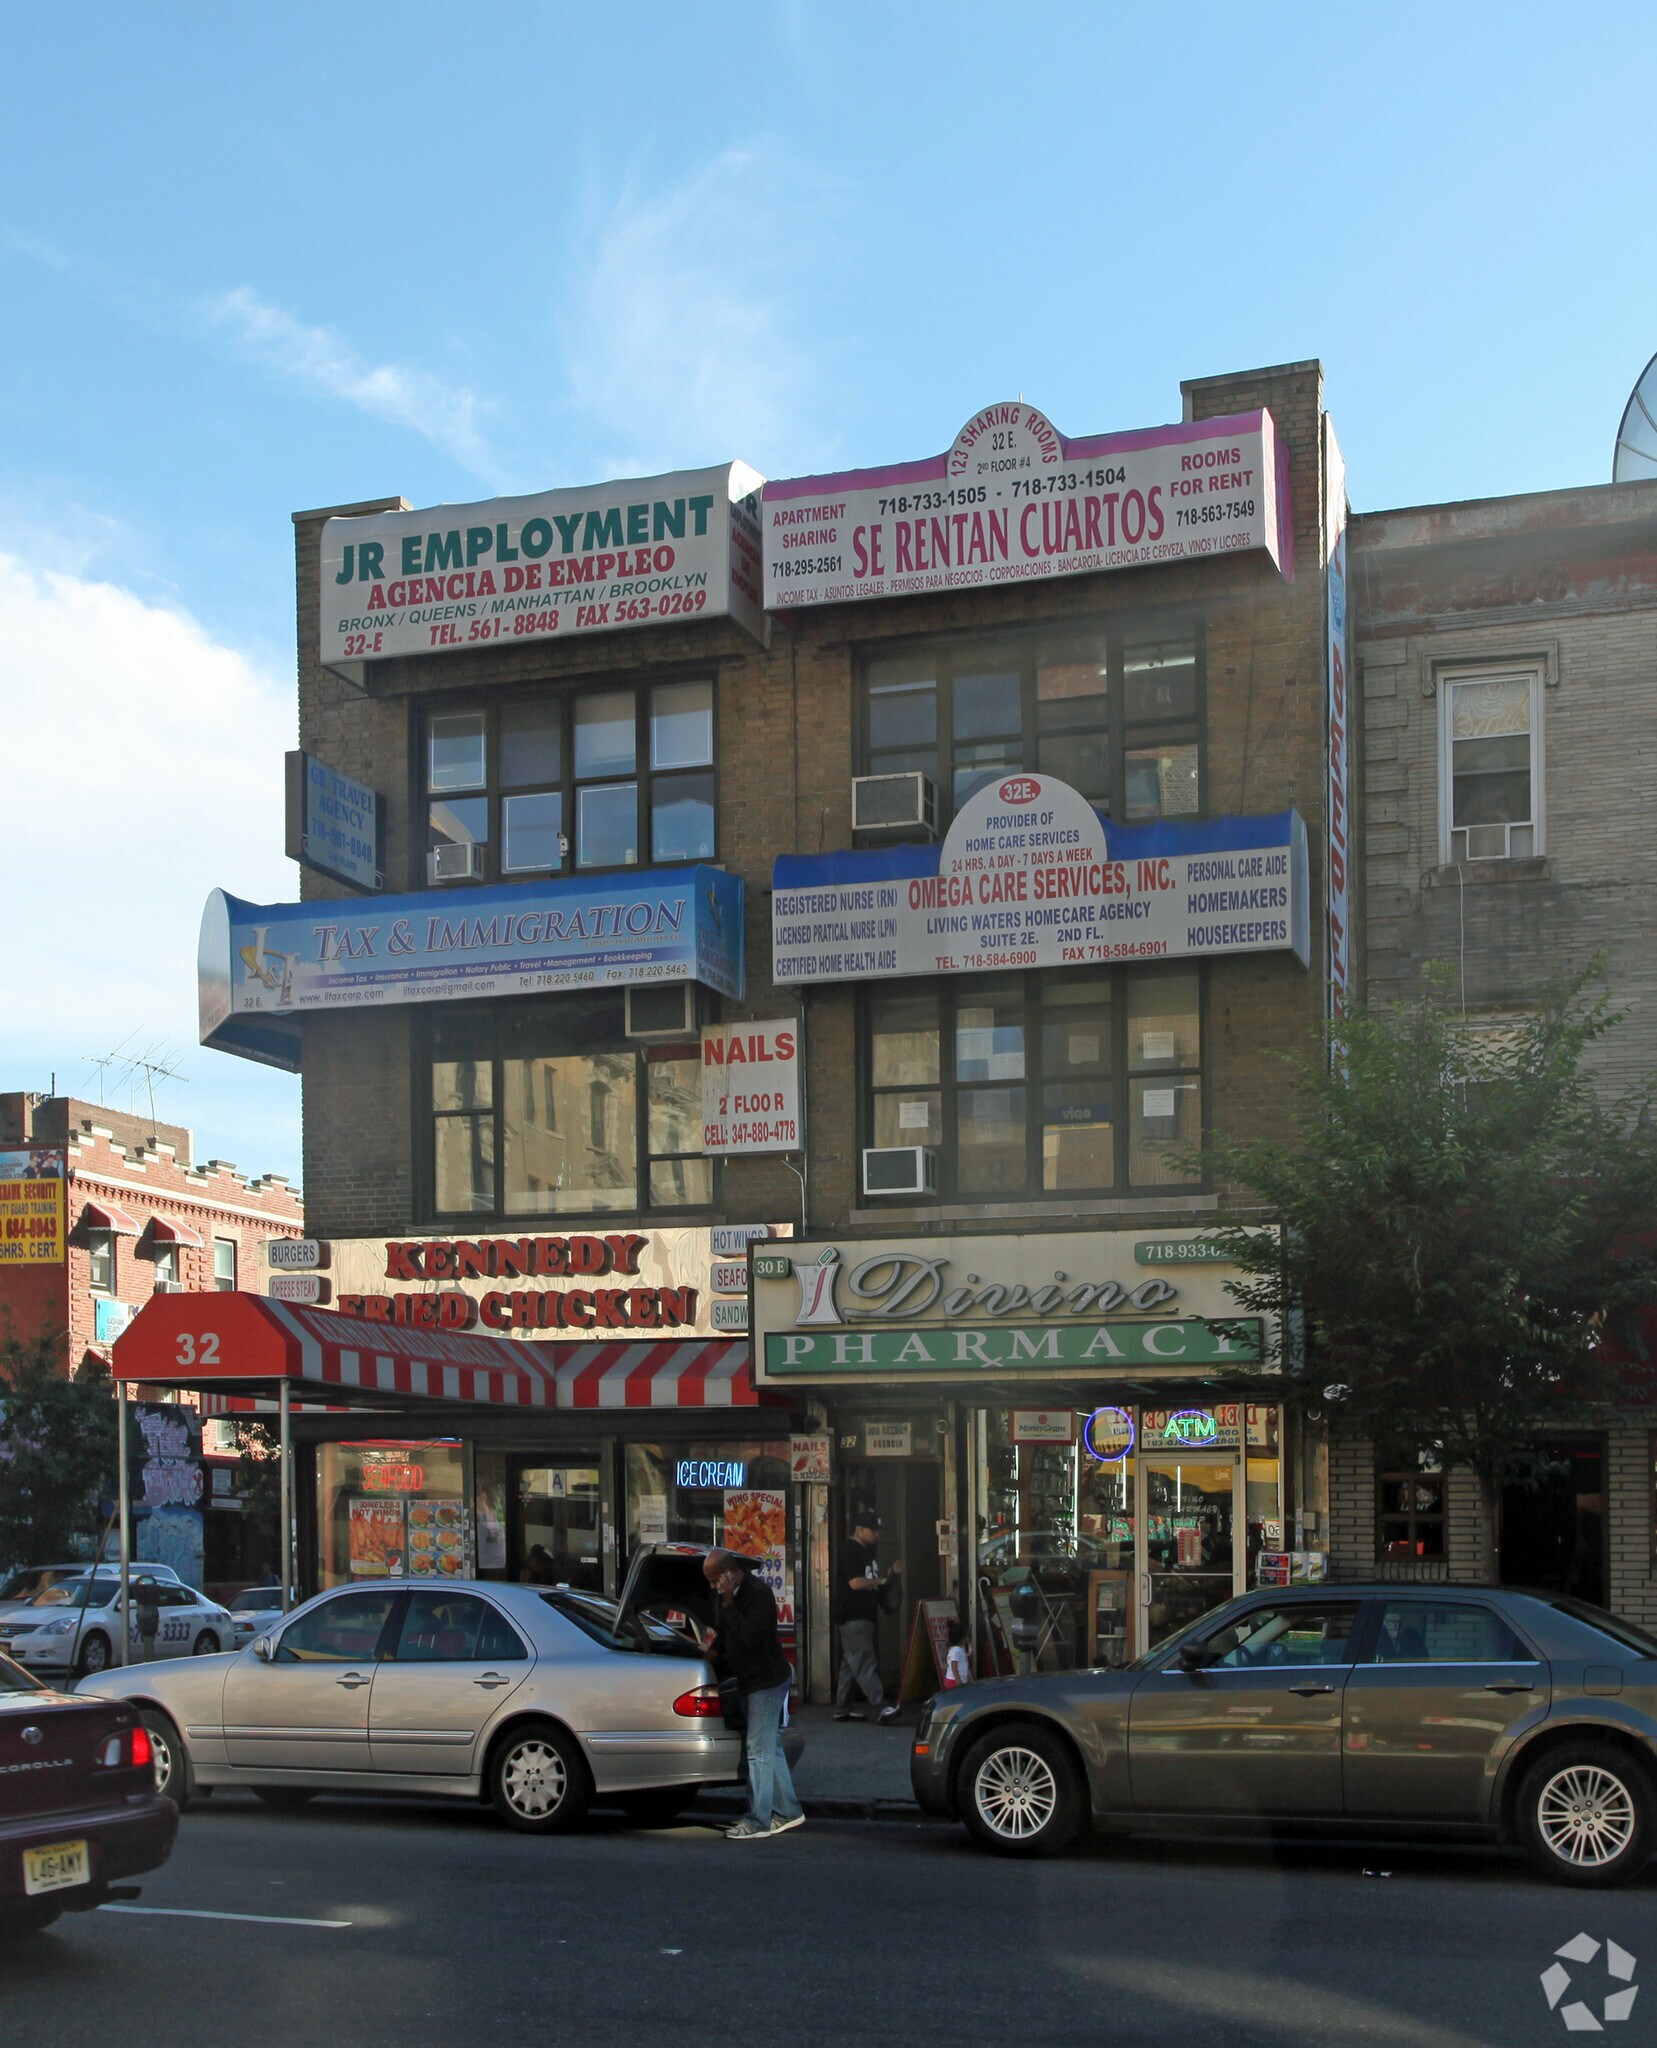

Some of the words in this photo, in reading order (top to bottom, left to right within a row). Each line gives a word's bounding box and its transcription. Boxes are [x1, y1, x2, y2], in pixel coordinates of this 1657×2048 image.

[951, 450, 969, 477] 123
[961, 406, 1021, 448] SHARING
[1025, 413, 1059, 465] ROOMS
[992, 432, 1005, 451] 32
[991, 459, 1018, 473] FLOOR
[1181, 447, 1241, 472] ROOMS
[879, 486, 987, 516] 718-733-1505
[1012, 466, 1126, 498] 718-733-1504
[1170, 478, 1204, 498] FOR
[1209, 470, 1254, 492] RENT
[773, 503, 847, 527] APARTMENT
[1176, 499, 1255, 527] 718-563-7549
[335, 541, 386, 585] JR
[402, 494, 715, 577] EMPLOYMENT
[782, 528, 837, 549] SHARING
[853, 524, 886, 579] SE
[896, 507, 1009, 574] RENTAN
[1020, 485, 1165, 558] CUARTOS
[367, 569, 497, 610] AGENCIA
[504, 562, 542, 594] DE
[549, 544, 675, 588] EMPLEO
[772, 555, 842, 579] 718-295-2561
[777, 589, 804, 606] INCOME
[806, 588, 819, 603] TAX
[824, 585, 855, 600] ASUNTOS
[856, 581, 885, 598] LEGALES
[891, 578, 924, 593] PERMISOS
[926, 575, 944, 589] PARA
[944, 571, 983, 587] NEGOCIOS
[990, 561, 1052, 581] CORPORACIONES
[1106, 548, 1139, 567] LICENCIA
[1141, 547, 1150, 560] DE
[1189, 537, 1212, 554] VINOS
[1220, 531, 1251, 549] LICORES
[338, 612, 396, 633] BRONX
[409, 603, 477, 625] QUEENS
[491, 588, 595, 614] MANHATTAN
[609, 572, 708, 599] BROOKLYN
[343, 632, 384, 657] 32-E
[430, 623, 463, 647] TEL.
[576, 602, 611, 628] FAX
[614, 589, 707, 623] 563-0269
[333, 774, 374, 814] TRAVEL
[319, 793, 364, 831] AGENCY
[986, 813, 1038, 830] PROVIDER
[1041, 812, 1053, 825] OF
[965, 837, 995, 852] HOME
[998, 834, 1026, 849] CARE
[1029, 829, 1080, 847] SERVICES
[952, 859, 963, 873] 24
[965, 856, 986, 872] HRS.
[989, 856, 995, 869] A
[997, 854, 1015, 869] DAY
[1023, 852, 1028, 866] 7
[1031, 850, 1054, 866] DAYS
[1057, 850, 1063, 863] A
[1065, 847, 1093, 863] WEEK
[1187, 859, 1236, 883] PERSONAL
[1238, 857, 1263, 880] CARE
[1265, 854, 1288, 877] AIDE
[908, 874, 974, 911] OMEGA
[979, 870, 1028, 905] CARE
[1033, 862, 1130, 901] SERVICES,
[1137, 858, 1176, 892] INC.
[776, 894, 837, 916] REGISTERED
[840, 889, 874, 911] NURSE
[877, 888, 898, 909] (RN)
[1187, 886, 1288, 914] HOMEMAKERS
[312, 925, 380, 961] TAX
[386, 919, 417, 956] &
[424, 899, 687, 953] IMMIGRATION
[776, 924, 811, 946] LICENSED
[813, 921, 849, 943] PRATICAL
[850, 919, 876, 941] NURSE
[878, 917, 898, 938] (LPN)
[926, 915, 968, 935] LIVING
[971, 911, 1021, 931] WATERS
[1100, 901, 1151, 921] AGENCY
[980, 932, 1016, 948] SUITE
[1020, 931, 1039, 946] 2E.
[1057, 928, 1081, 943] 2ND
[1085, 926, 1104, 941] FL.
[1187, 920, 1287, 947] HOUSEKEEPERS
[329, 976, 354, 985] Income
[356, 975, 368, 983] Tax
[374, 971, 409, 981] Insurance
[416, 967, 457, 979] Immigration
[465, 965, 489, 976] Notary
[490, 963, 512, 973] Public
[520, 960, 541, 970] Travel
[546, 956, 596, 969] Management
[604, 951, 653, 964] Bookkeeping
[776, 955, 817, 977] CERTIFIED
[819, 953, 842, 974] HOME
[844, 951, 876, 973] HEALTH
[877, 950, 897, 970] AIDE
[935, 955, 960, 970] TEL.
[963, 950, 1037, 968] 718-584-6900
[1062, 946, 1085, 961] FAX
[1088, 940, 1168, 958] 718-584-6901
[704, 1032, 795, 1066] NAILS
[704, 1124, 728, 1146] CELL:
[732, 1120, 796, 1145] 347-880-4778
[24, 1182, 57, 1200] SECURITY
[31, 1201, 57, 1214] TRAINING
[713, 1231, 732, 1249] HOT
[271, 1246, 315, 1264] BURGERS
[385, 1234, 648, 1280] KENNEDY
[757, 1260, 774, 1274] 30
[777, 1261, 785, 1273] E
[271, 1281, 317, 1299] CHEESESTEAK
[842, 1252, 1177, 1319] Divino
[337, 1291, 478, 1331] FRIED
[480, 1286, 699, 1331] CHICKEN
[175, 1332, 221, 1365] 32
[1019, 1424, 1066, 1434] MoneyGram
[1164, 1418, 1217, 1438] ATM
[793, 1442, 828, 1452] NAILS
[362, 1464, 424, 1491] SEAFOOD
[552, 1473, 563, 1491] A
[676, 1461, 698, 1487] ICE
[699, 1461, 745, 1487] CREAM
[372, 1508, 401, 1516] WINGS
[726, 1494, 749, 1507] WING
[750, 1491, 784, 1508] SPECIAL
[0, 1758, 74, 1774] COROLLA
